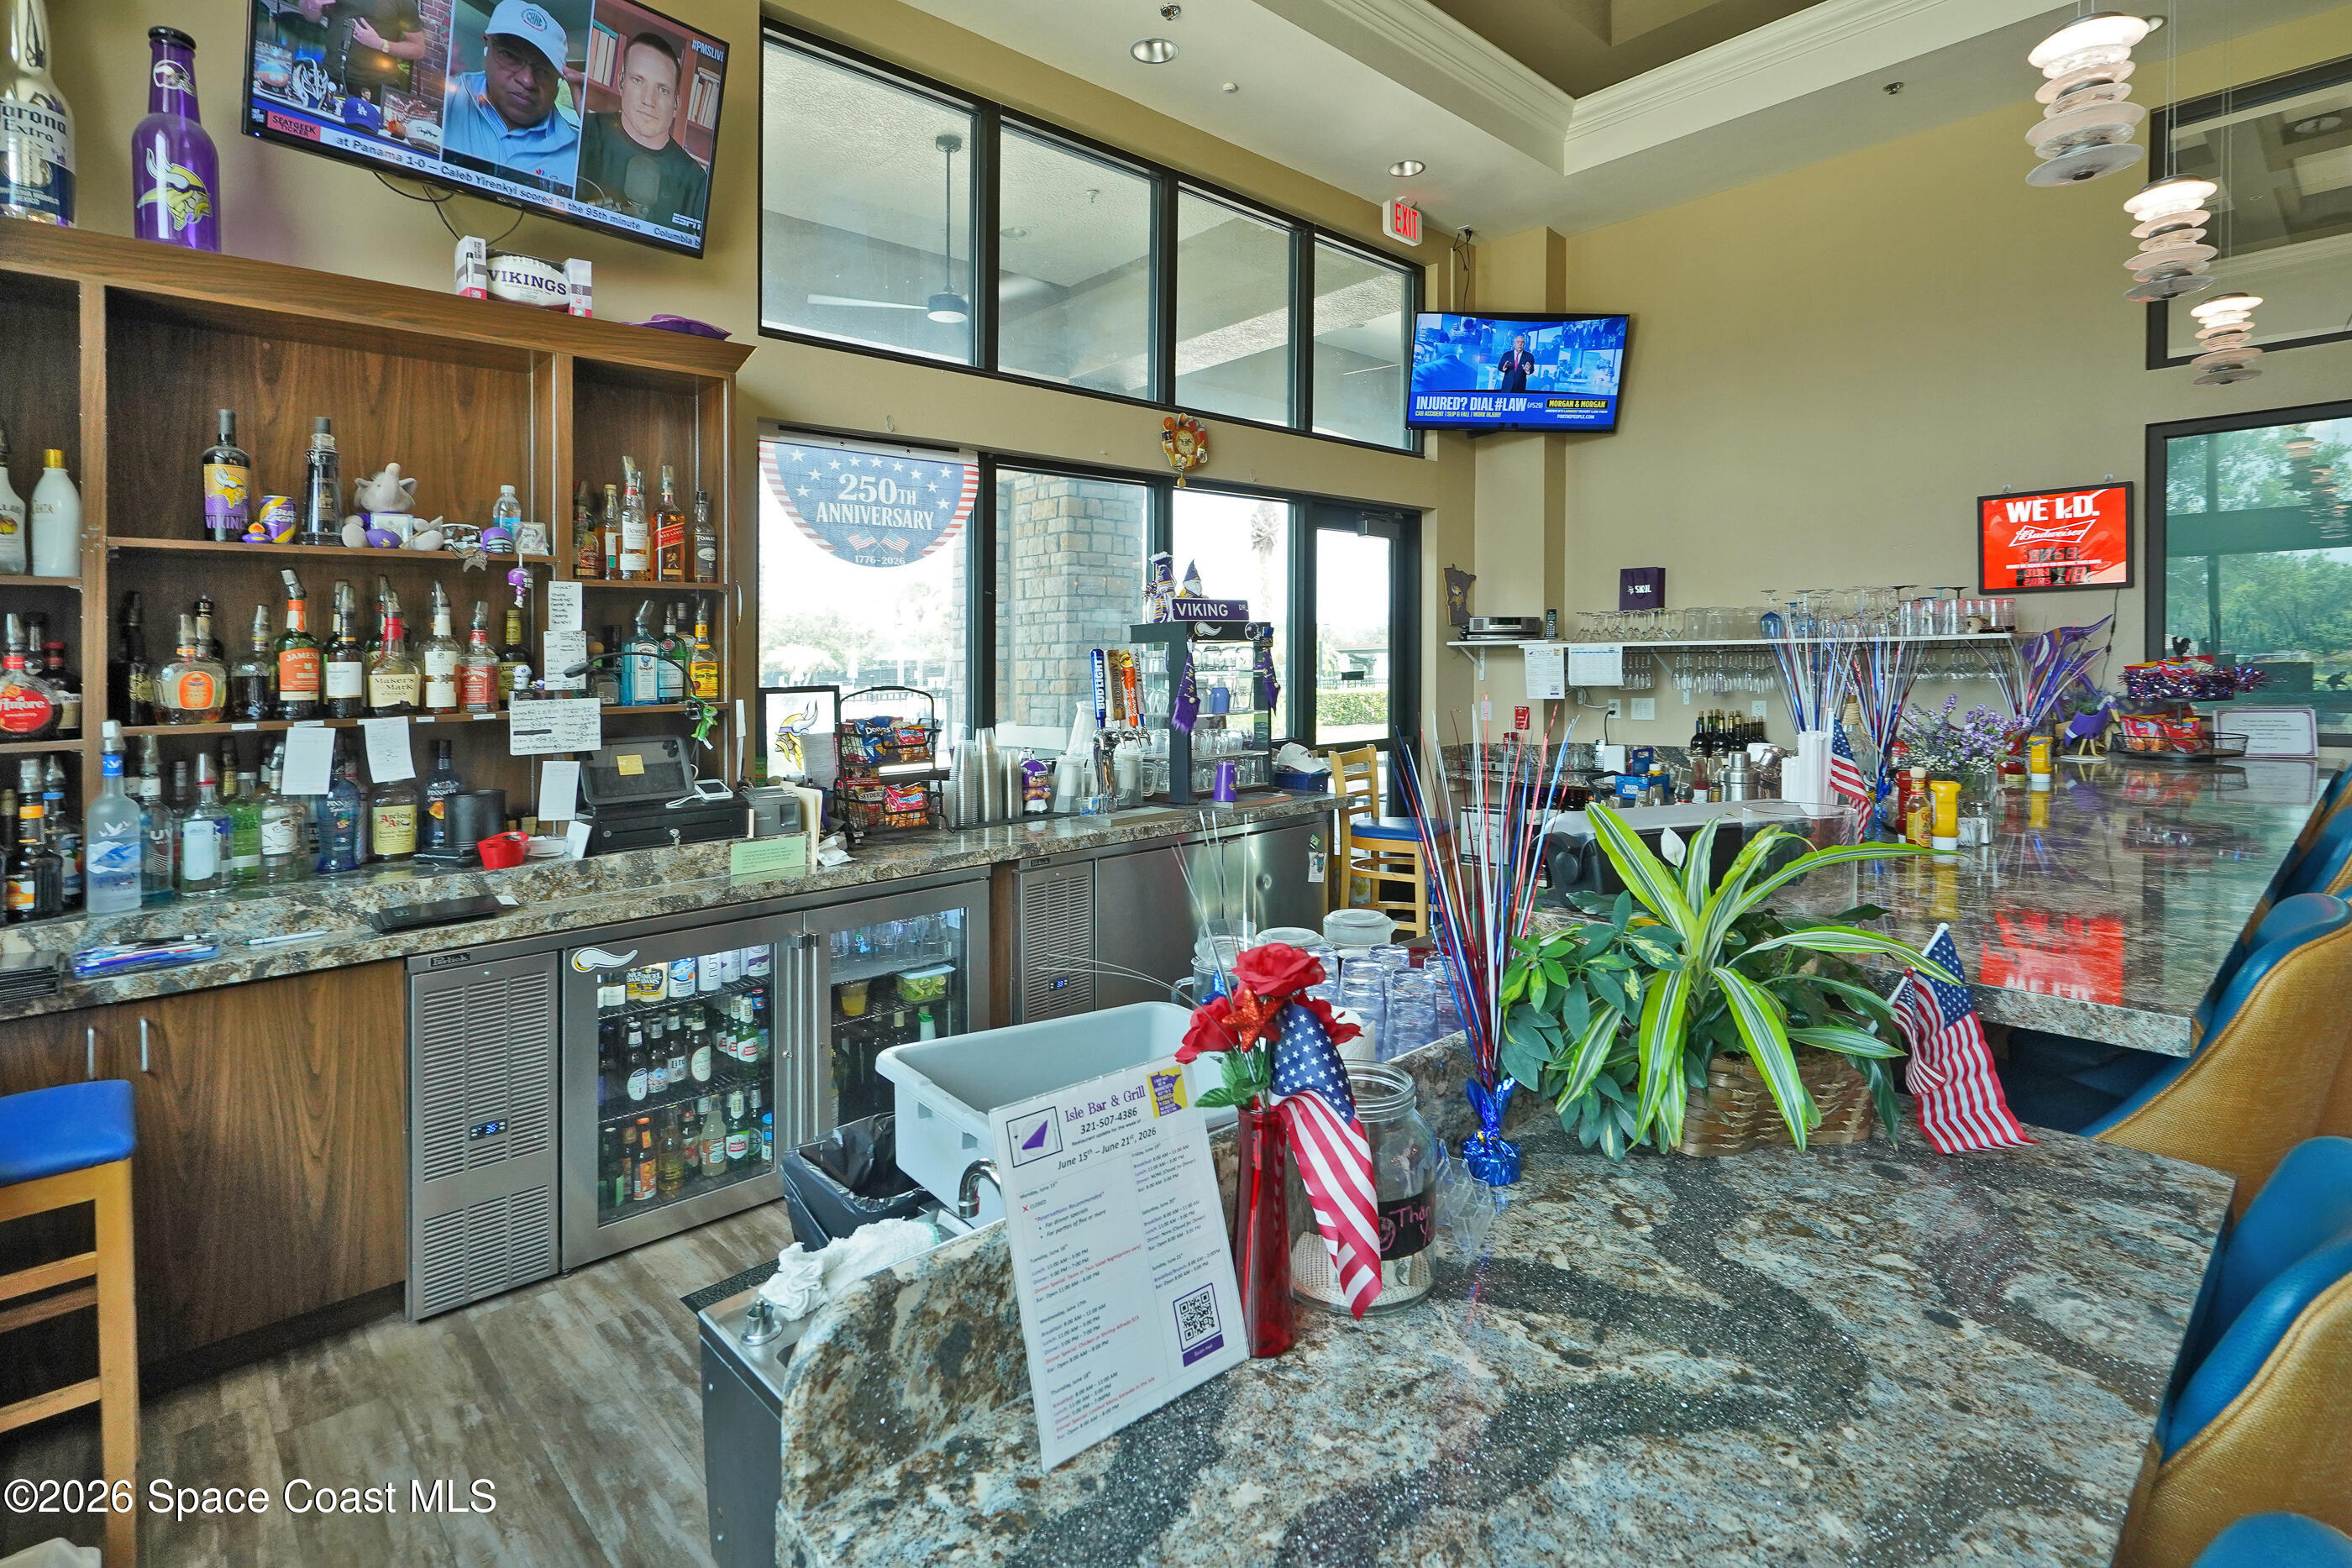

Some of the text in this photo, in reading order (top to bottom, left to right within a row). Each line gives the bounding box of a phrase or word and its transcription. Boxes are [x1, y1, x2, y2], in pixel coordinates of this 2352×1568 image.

[1, 103, 68, 136] orona
[272, 114, 317, 135] SEATGEEK
[336, 137, 349, 148] at
[353, 139, 403, 163] Panama
[407, 155, 425, 168] 1-0
[441, 165, 472, 182] Caleb
[519, 189, 553, 206] scored
[554, 198, 565, 209] in
[568, 202, 583, 214] the
[585, 206, 607, 221] 95th
[610, 212, 641, 230] minute
[654, 227, 693, 244] Columbia
[671, 212, 701, 231] ESPN
[1395, 202, 1418, 240] EXIT
[487, 269, 567, 296] VIKINGS
[1416, 396, 1467, 411] INJURED?
[1548, 400, 1574, 408] MORGAN
[838, 474, 916, 506] 250TH
[816, 501, 934, 531] ANNIVERSARY
[2005, 499, 2049, 523] WE
[2018, 527, 2085, 542] Budweiser
[1176, 603, 1228, 617] VIKING
[286, 652, 319, 662] JAMES
[1063, 1083, 1146, 1123] Isle Bar & Grill
[1079, 1106, 1138, 1135] 321-507-4386
[1056, 1156, 1077, 1170] June
[1077, 1147, 1094, 1162] 15th
[1100, 1140, 1120, 1155] June
[1137, 1125, 1157, 1141] 2026
[1071, 1134, 1095, 1146] Restaurant
[1029, 1198, 1047, 1209] CLOSED
[1044, 1206, 1089, 1229] For dinner specials
[1054, 1222, 1072, 1235] parties
[1094, 1209, 1106, 1218] more
[1073, 1314, 1082, 1322] AM
[1097, 1302, 1106, 1310] AM
[1070, 1324, 1079, 1333] AM
